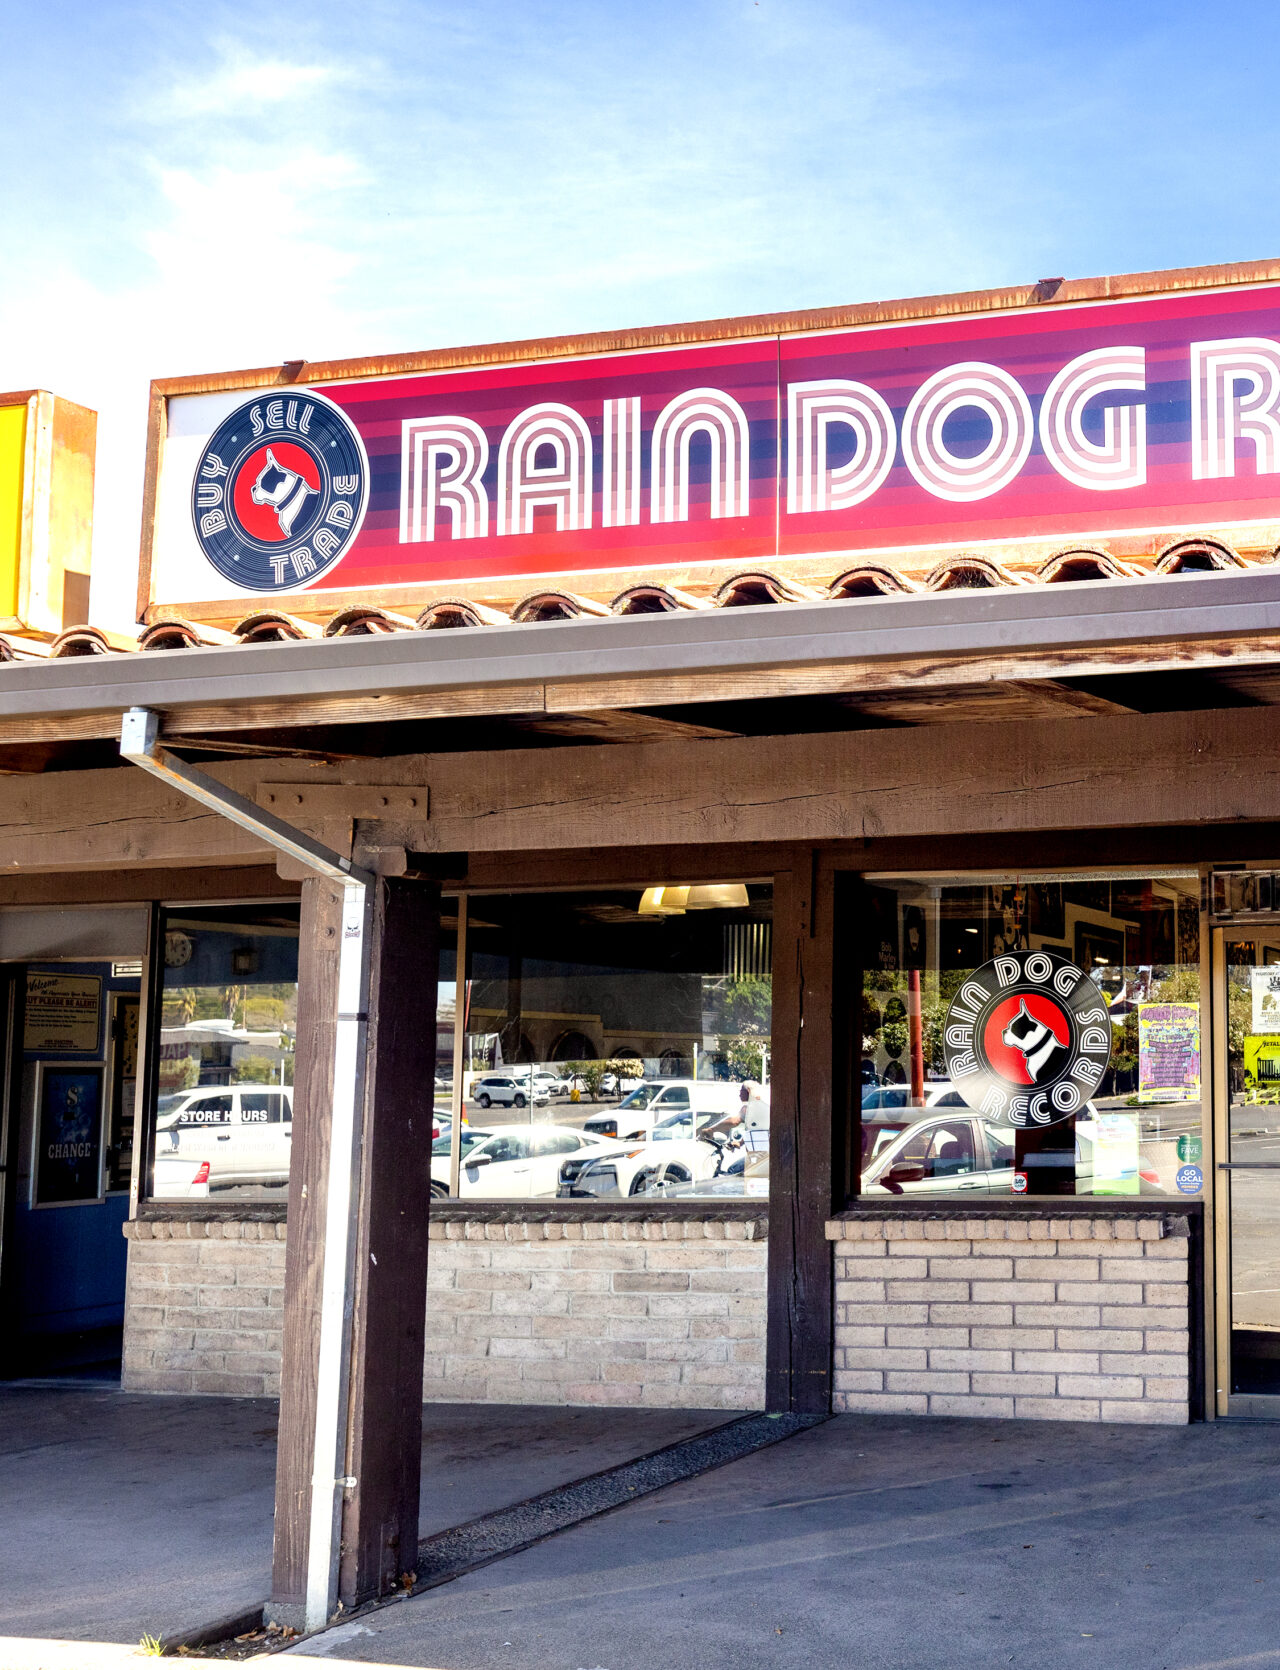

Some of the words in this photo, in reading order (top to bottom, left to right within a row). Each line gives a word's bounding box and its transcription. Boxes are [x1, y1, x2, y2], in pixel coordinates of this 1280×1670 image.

[250, 400, 314, 437] SELL
[399, 387, 750, 544] RAIN
[787, 346, 1147, 514] DOG
[197, 452, 229, 538] BUY
[270, 474, 359, 584] TRADE
[946, 981, 991, 1079] RAIN
[994, 953, 1082, 997] DOG
[979, 1008, 1108, 1126] RECORDS
[48, 1142, 91, 1159] CHANGE
[180, 1111, 221, 1122] STORE
[224, 1111, 268, 1121] HURS
